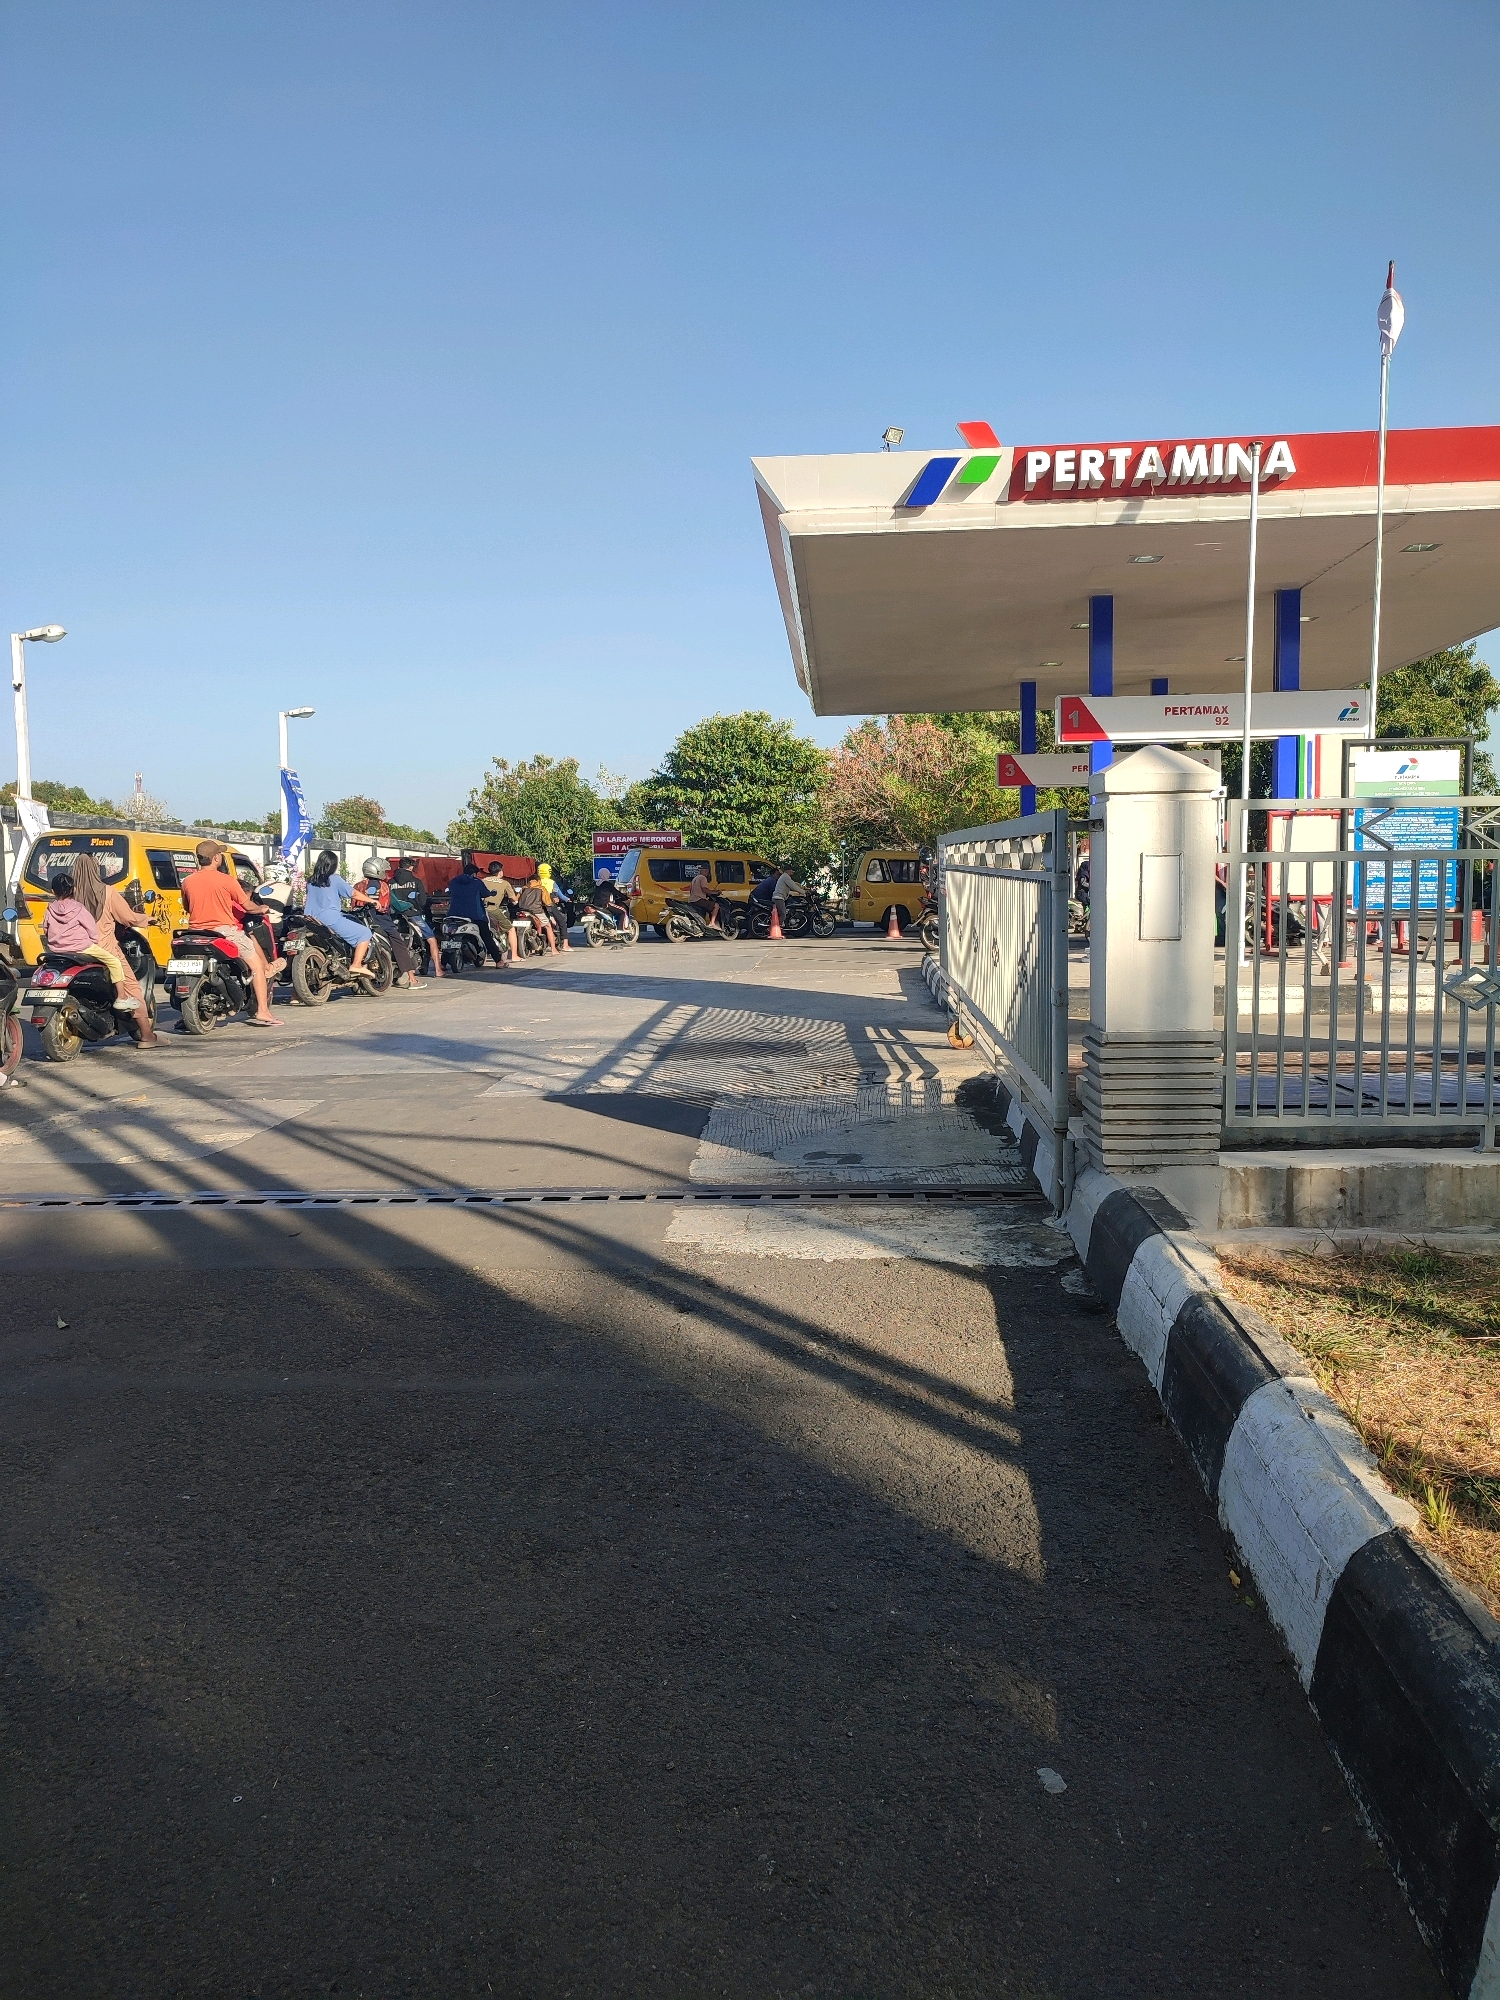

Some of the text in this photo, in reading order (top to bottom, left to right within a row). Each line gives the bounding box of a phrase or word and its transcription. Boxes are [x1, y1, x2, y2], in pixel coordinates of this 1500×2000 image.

[1025, 440, 1297, 491] PERTAMINA
[1164, 705, 1229, 716] PERTAMAX
[1068, 710, 1080, 728] 1
[1215, 716, 1230, 726] 92
[1004, 763, 1016, 777] 3
